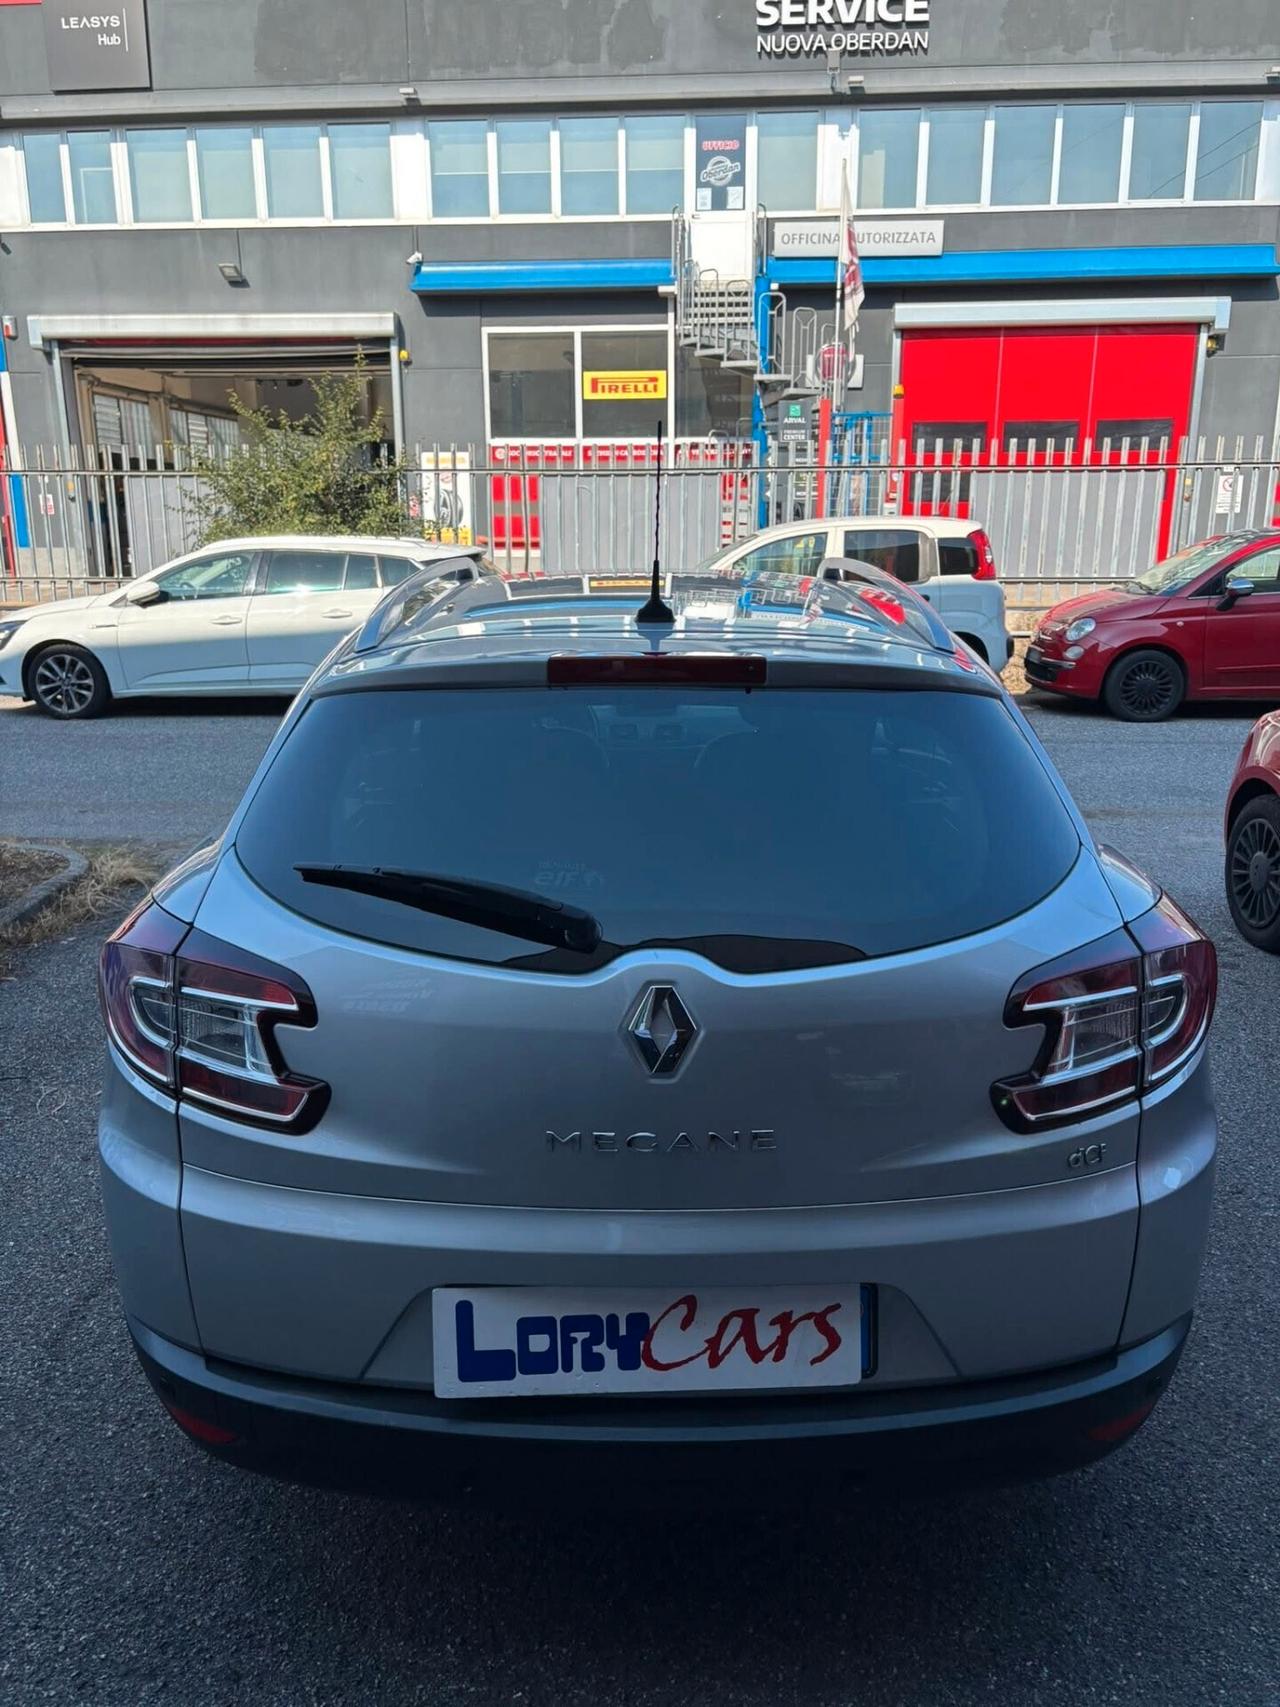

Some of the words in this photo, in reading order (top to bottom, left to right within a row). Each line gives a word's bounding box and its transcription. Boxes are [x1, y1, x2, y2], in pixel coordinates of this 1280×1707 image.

[756, 0, 930, 26] SERVICE
[97, 33, 121, 46] Hub
[757, 34, 827, 52] NUOVA
[831, 32, 929, 51] OBERDAN
[781, 232, 840, 245] OFFICINA
[850, 231, 936, 245] UTORIZZATA
[591, 376, 658, 393] PIRELLI
